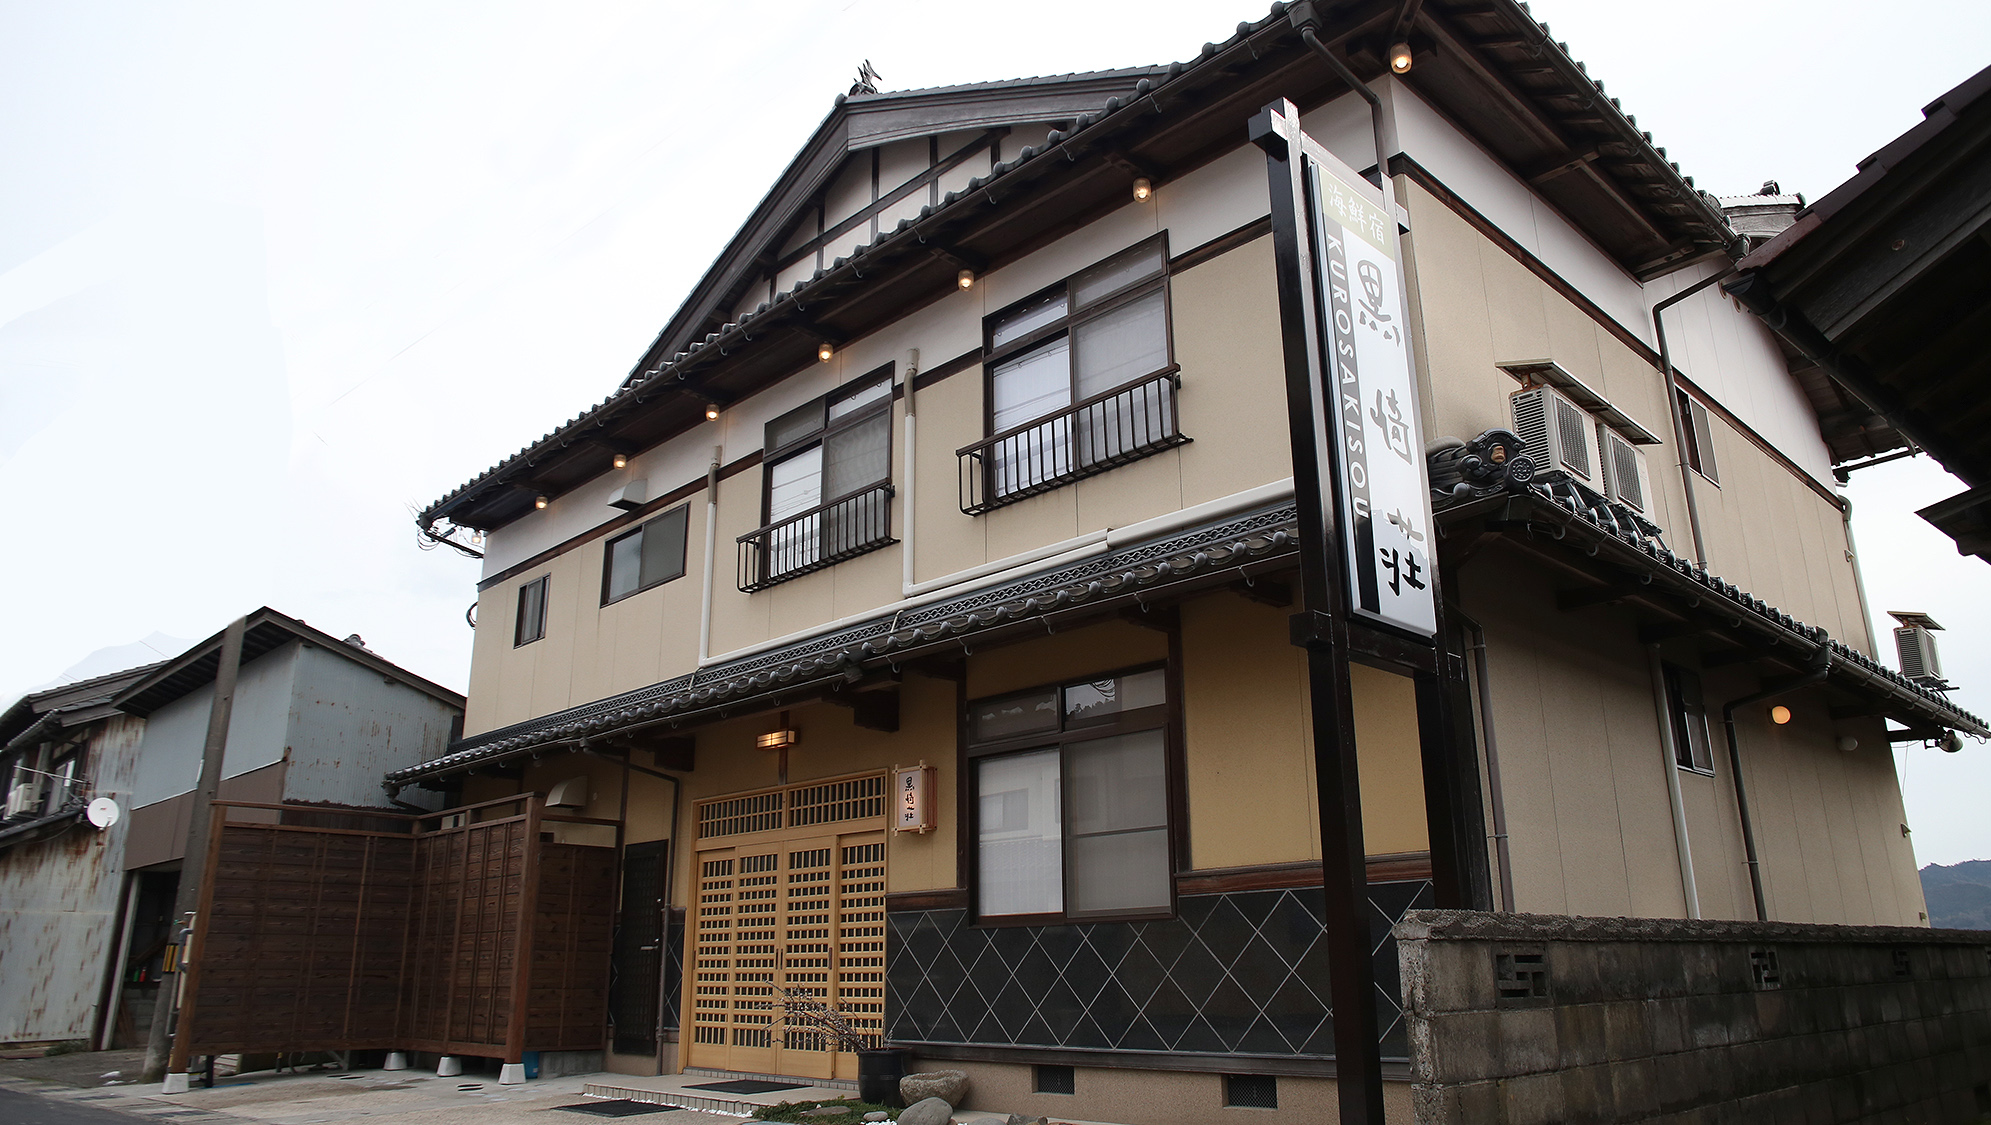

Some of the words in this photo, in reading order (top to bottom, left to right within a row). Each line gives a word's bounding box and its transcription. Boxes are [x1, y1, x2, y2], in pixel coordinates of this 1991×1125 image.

[1328, 183, 1385, 245] 海鮮宿
[1327, 233, 1370, 519] KUROSAKISOU
